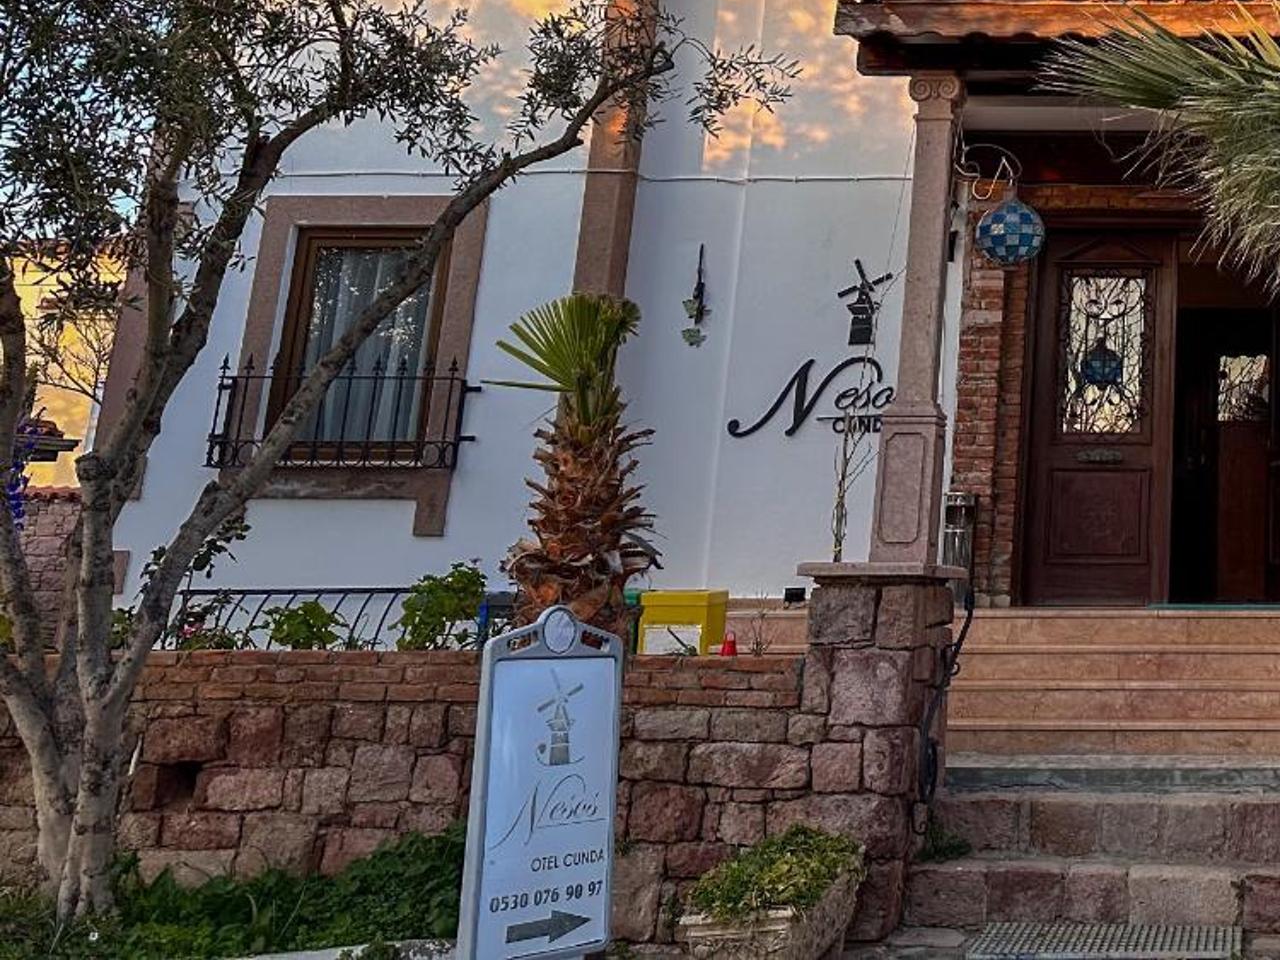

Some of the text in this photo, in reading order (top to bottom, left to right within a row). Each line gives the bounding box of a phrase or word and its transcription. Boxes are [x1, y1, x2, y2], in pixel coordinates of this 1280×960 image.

[727, 355, 897, 438] Neso
[832, 416, 884, 434] CUND
[530, 848, 605, 872] OTEL CUNDA
[489, 880, 603, 913] 0530 076 90 97
